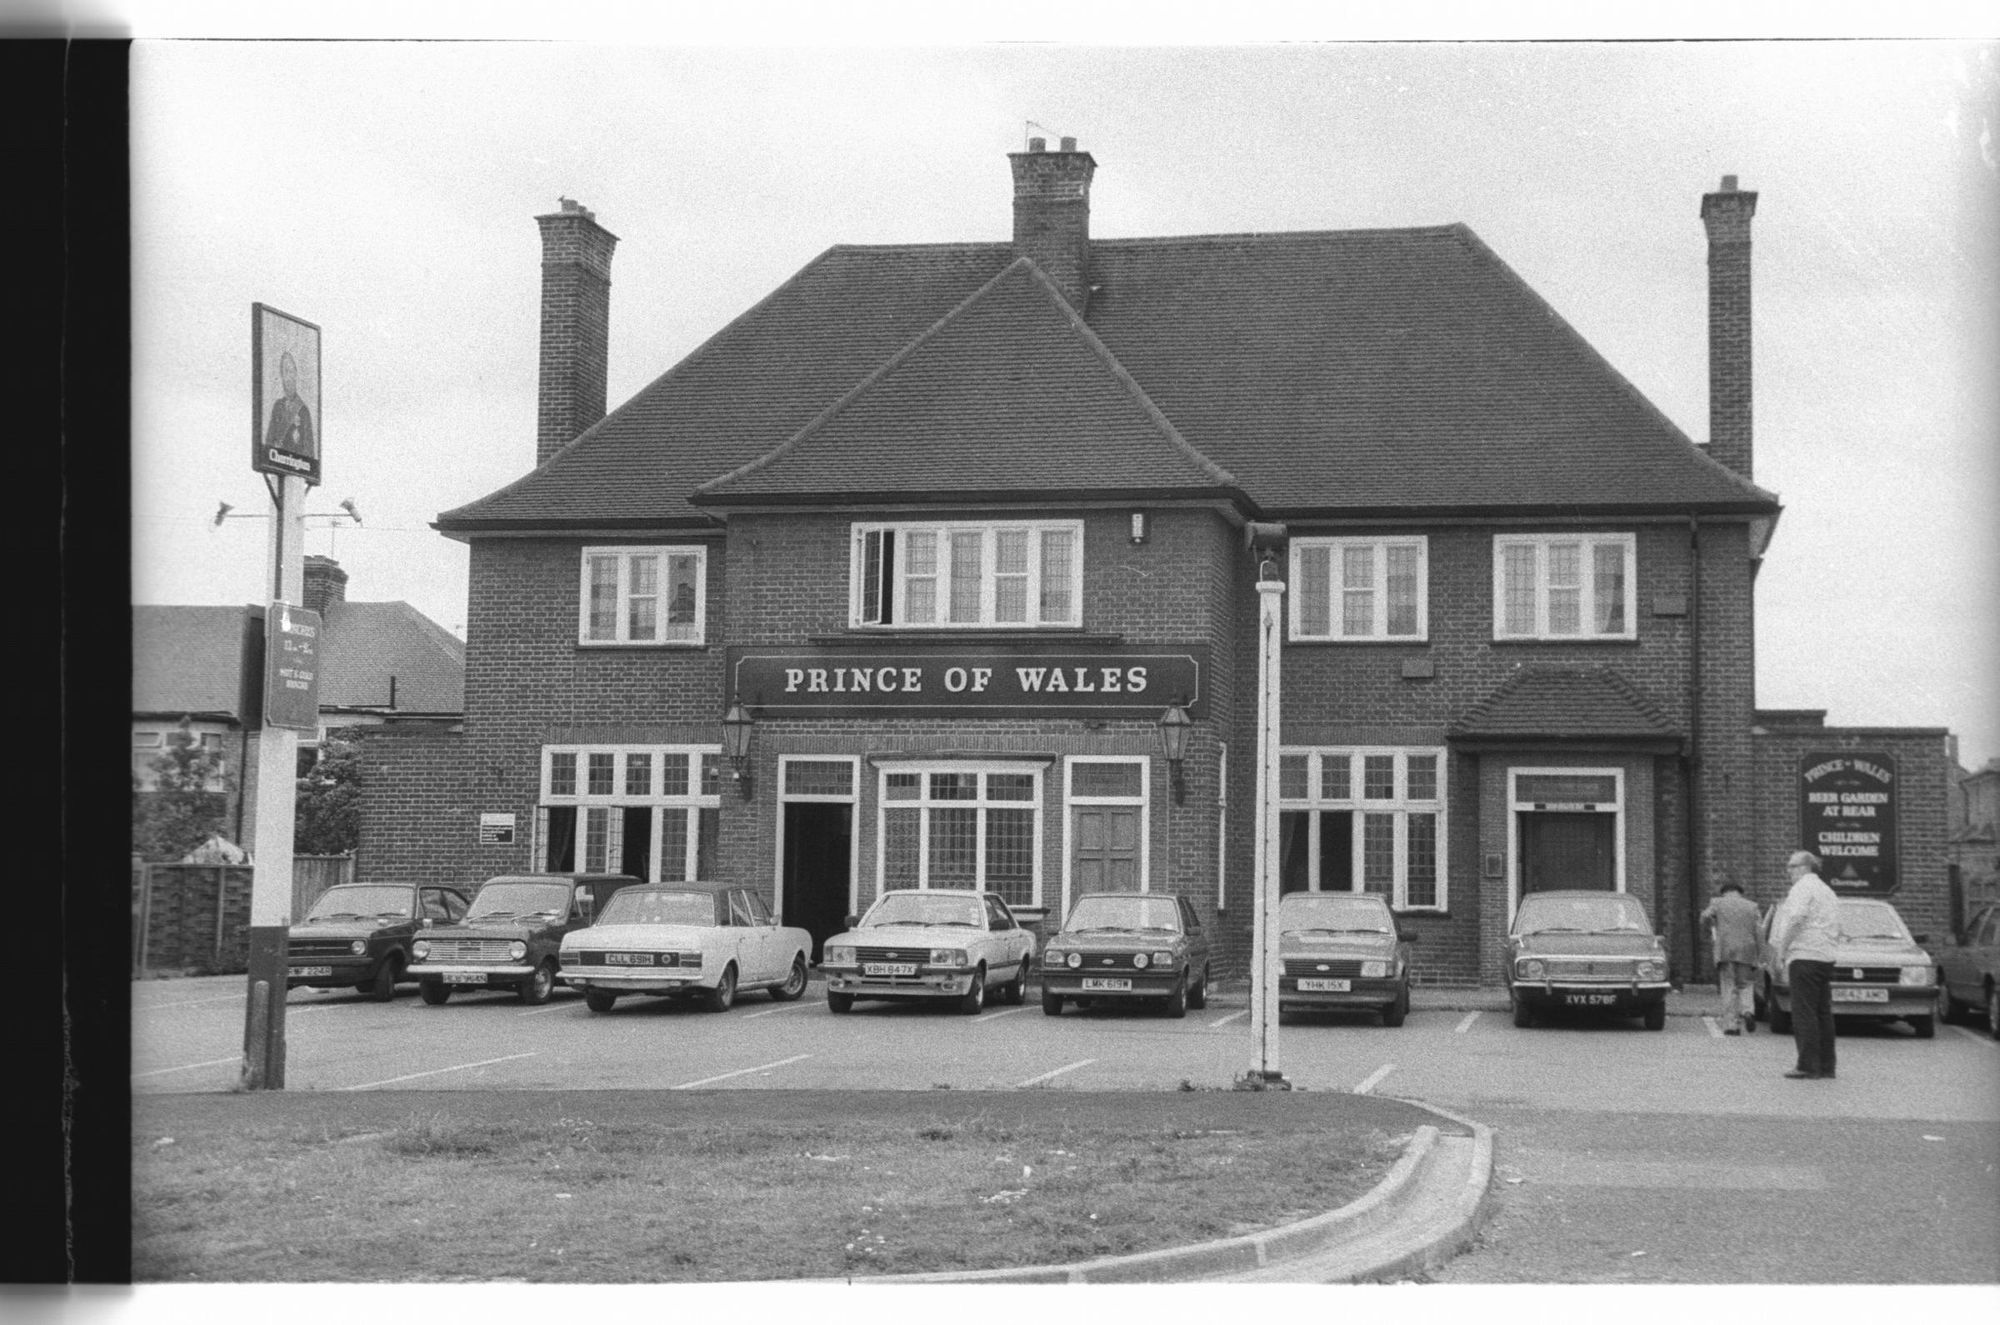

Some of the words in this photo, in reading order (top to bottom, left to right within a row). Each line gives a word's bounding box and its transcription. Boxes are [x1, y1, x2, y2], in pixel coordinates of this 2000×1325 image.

[784, 666, 922, 693] PRINCE
[944, 667, 992, 692] OF
[1016, 667, 1148, 693] WALES
[1804, 759, 1844, 783] PRINCE
[1853, 759, 1893, 783] WALES
[1808, 792, 1839, 803] BEER
[1840, 792, 1888, 803] GARDEN
[1823, 805, 1839, 817] AT
[1841, 805, 1877, 817] REAR
[1818, 831, 1881, 844] CHILDREN
[1818, 844, 1880, 857] WELCOME
[866, 964, 886, 974] XBH
[888, 964, 914, 974] 847X
[1085, 979, 1105, 989] LMK
[1107, 979, 1129, 989] 619W
[1304, 980, 1325, 990] YHK
[1327, 980, 1344, 990] 15X
